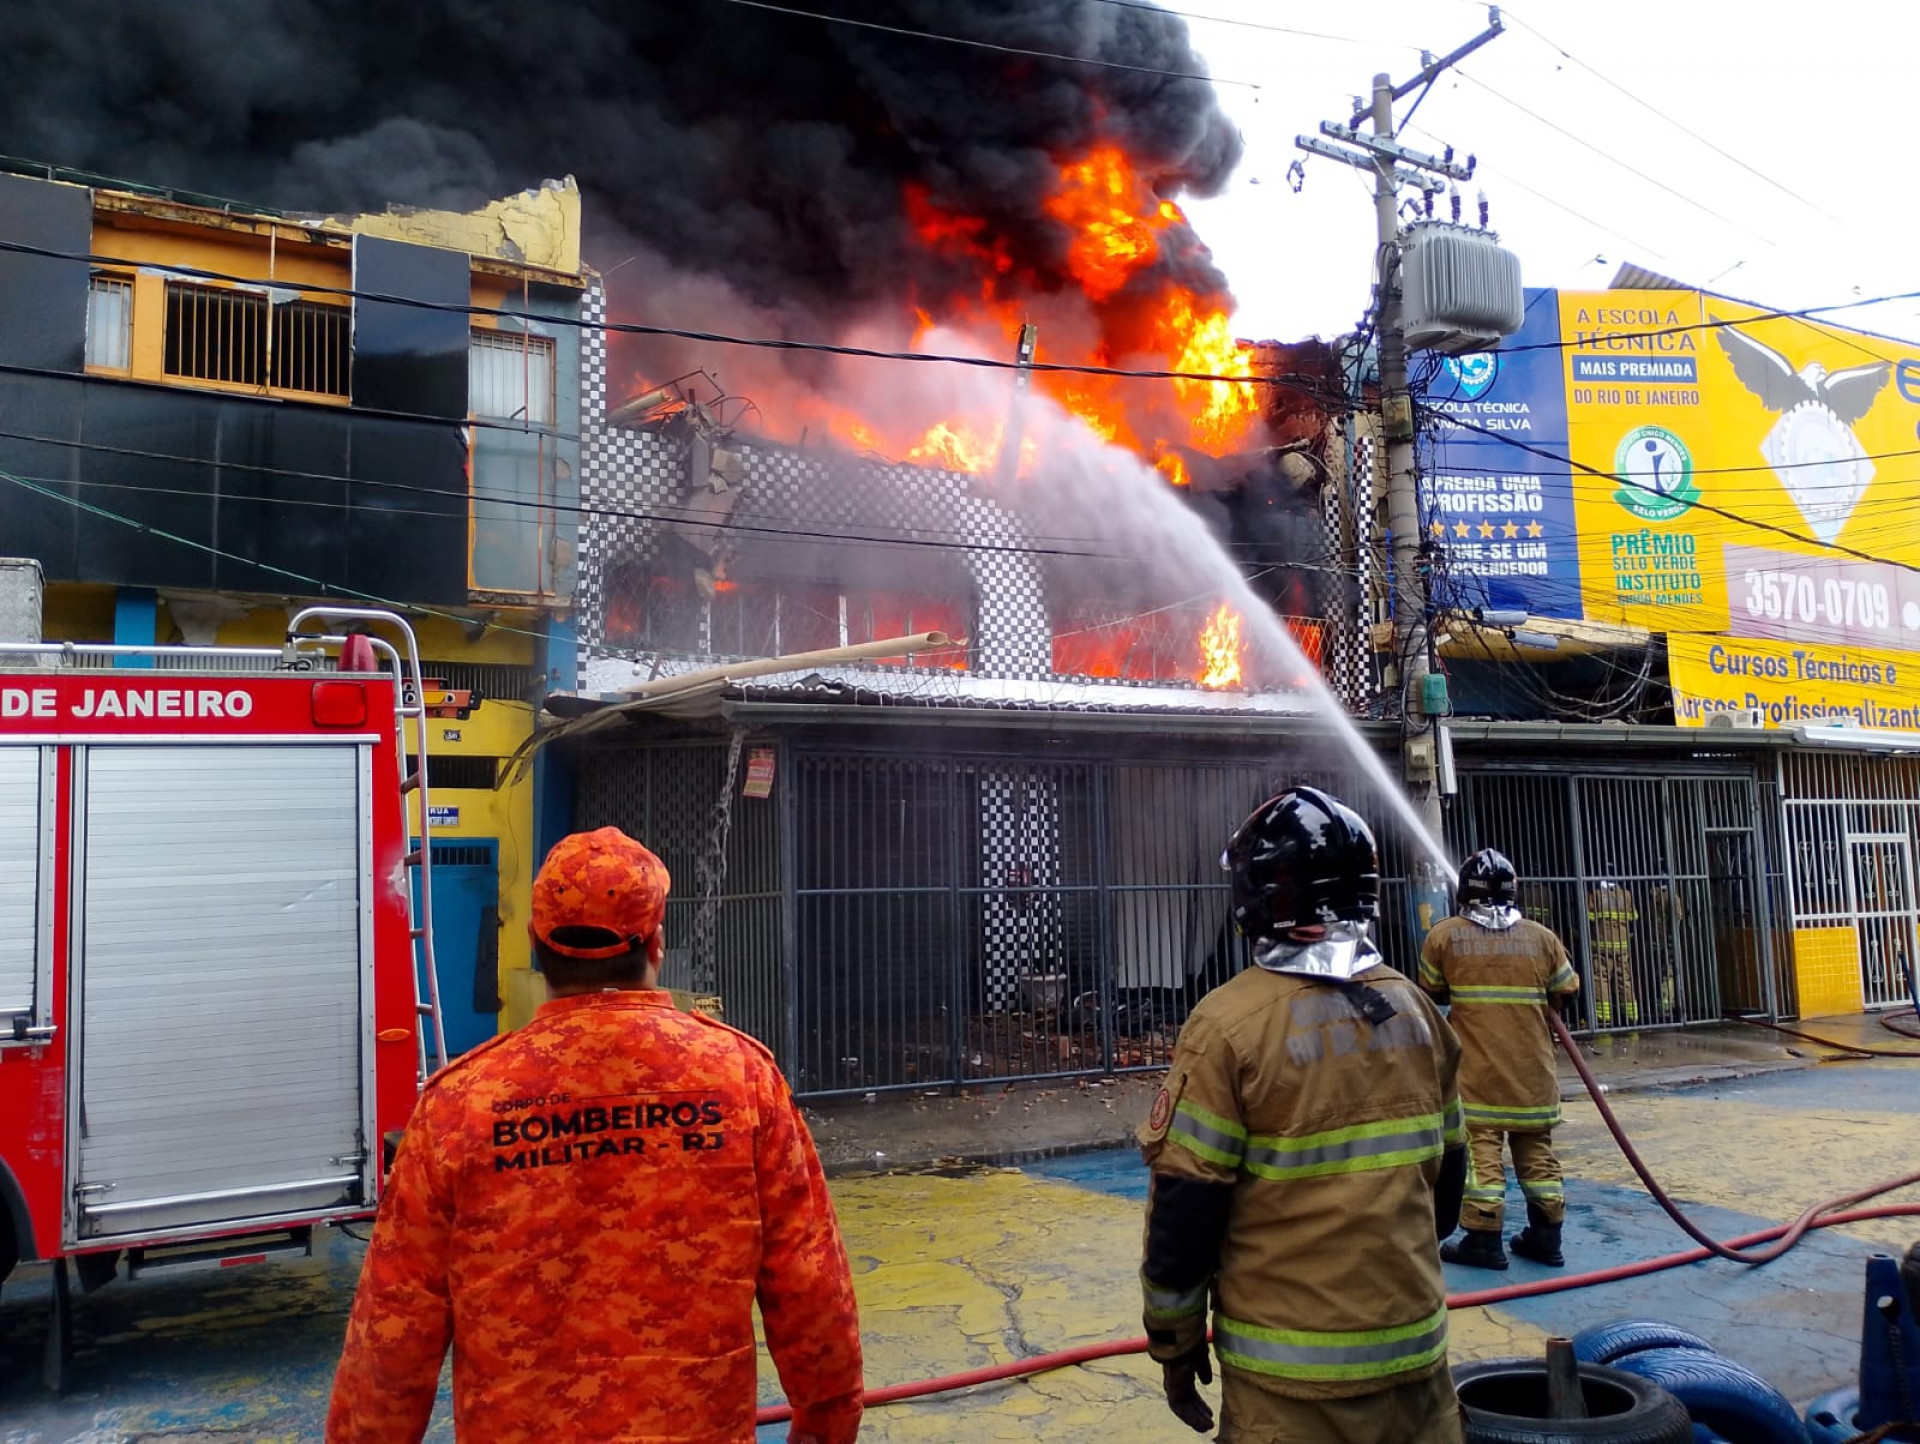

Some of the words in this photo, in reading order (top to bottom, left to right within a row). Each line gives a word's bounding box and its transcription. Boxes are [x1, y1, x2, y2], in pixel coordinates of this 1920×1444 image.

[1577, 308, 1590, 324] A
[1597, 308, 1680, 325] ESCOLA
[1573, 327, 1696, 351] TÉCNICA
[1580, 361, 1616, 375] MAIS
[1620, 361, 1693, 377] PREMIADA
[1574, 388, 1592, 404] DO
[1597, 389, 1621, 405] RIO
[1625, 389, 1641, 405] DE
[1646, 390, 1700, 406] JANEIRO
[1474, 400, 1530, 414] TÉCNICA
[1486, 418, 1531, 430] SILVA
[1421, 476, 1497, 491] APRENDA
[1502, 476, 1542, 491] UMA
[1423, 491, 1543, 512] PROFISSÃO
[1516, 542, 1548, 559] UM
[1611, 528, 1695, 555] PRÊMIO
[1613, 556, 1648, 571] SELO
[1653, 555, 1697, 570] VERDE
[1616, 573, 1701, 591] INSTITUTO
[1656, 593, 1703, 605] MENDES
[1744, 568, 1890, 630] 3570-0709
[1709, 644, 1789, 678] Cursos
[1792, 650, 1882, 685] Técnicos
[1885, 664, 1897, 685] e
[1, 688, 58, 718] DE
[71, 688, 253, 718] JANEIRO
[491, 1096, 546, 1114] CORPO
[550, 1092, 571, 1105] DE
[492, 1100, 723, 1148] BOMBEIROS
[494, 1136, 646, 1173] MILITAR
[682, 1131, 724, 1152] RJ
